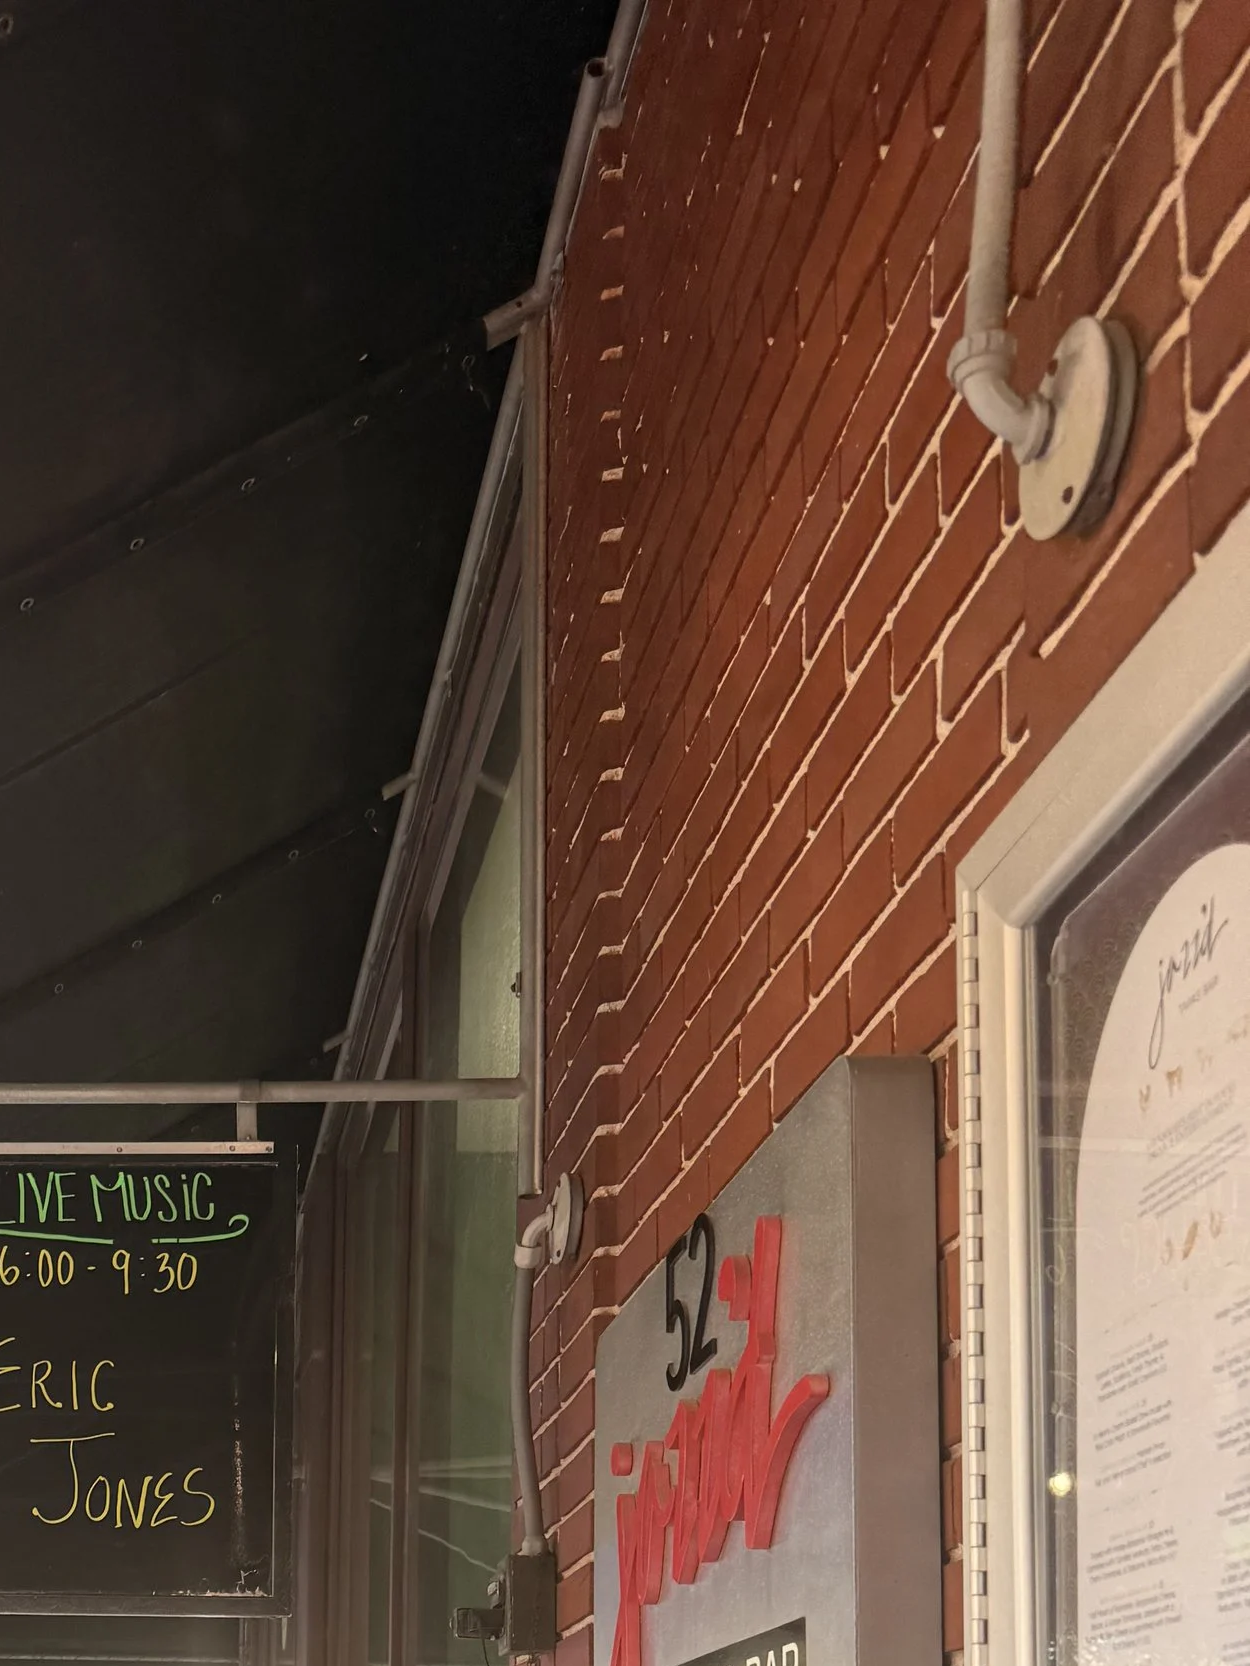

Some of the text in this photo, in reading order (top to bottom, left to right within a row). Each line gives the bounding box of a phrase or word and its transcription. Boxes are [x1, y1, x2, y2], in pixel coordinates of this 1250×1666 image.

[0, 1245, 75, 1288] 6:00
[111, 1249, 198, 1295] 9:30
[665, 1212, 719, 1391] 52
[30, 1432, 216, 1529] JONES
